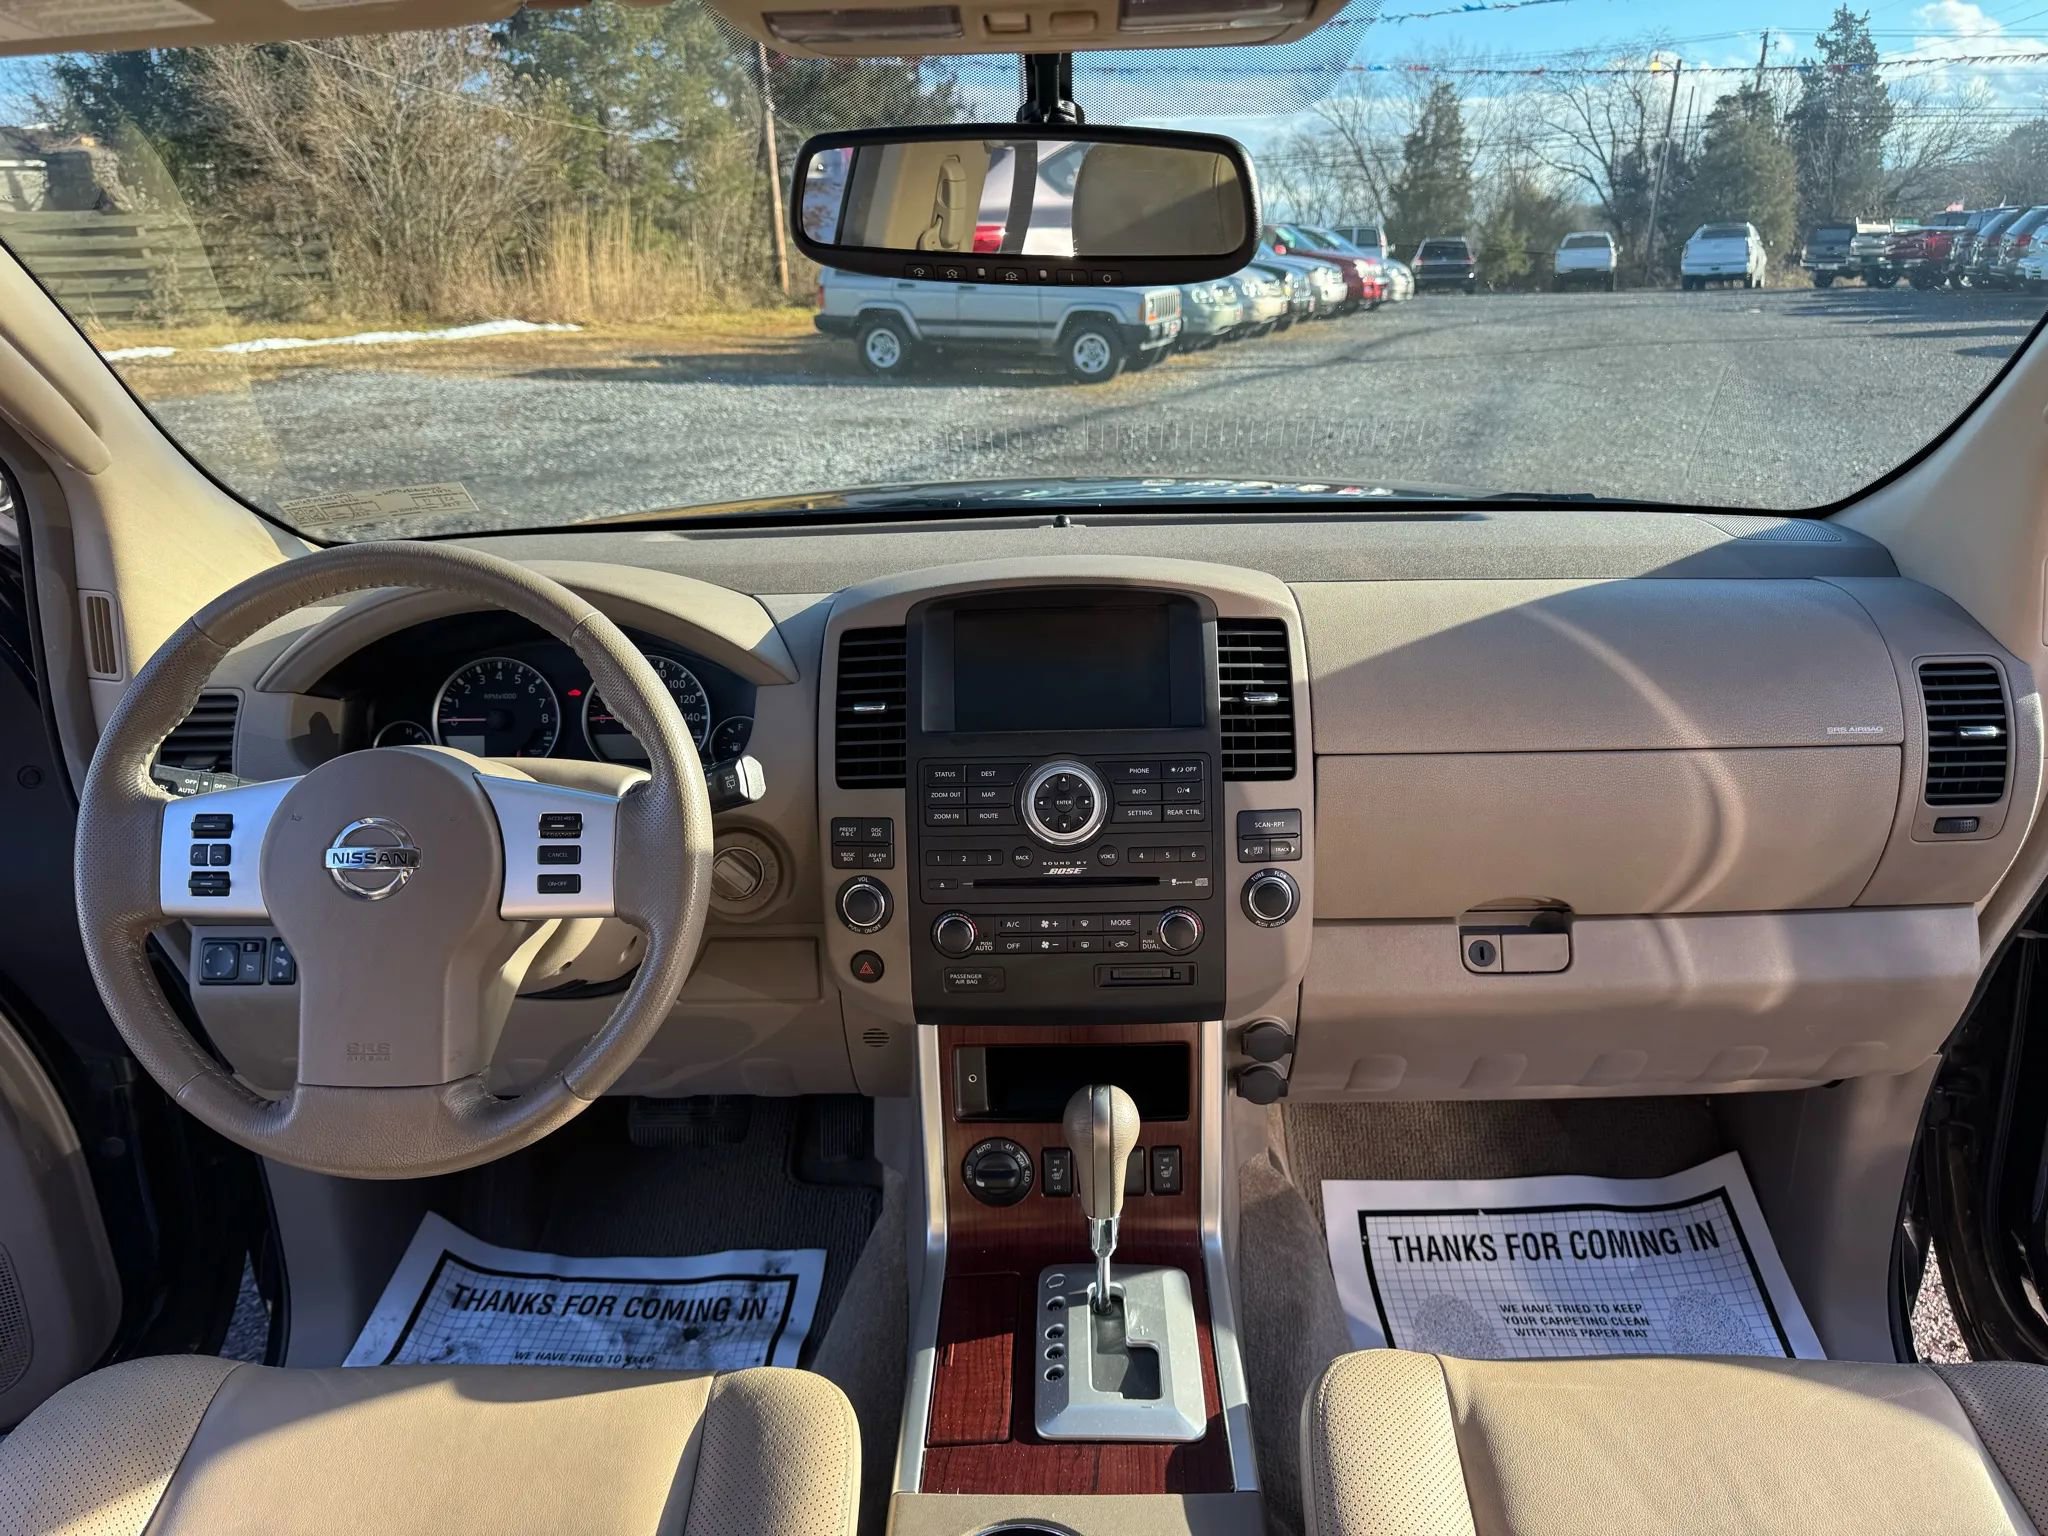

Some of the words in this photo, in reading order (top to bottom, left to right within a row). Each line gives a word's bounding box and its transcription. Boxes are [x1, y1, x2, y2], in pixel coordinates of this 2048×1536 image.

[480, 675, 485, 685] 3
[496, 672, 503, 680] 4
[515, 675, 521, 684] 5
[464, 684, 471, 694] 2
[528, 684, 535, 694] 6
[669, 680, 686, 689] 100
[455, 699, 459, 708] 1
[539, 698, 546, 708] 7
[680, 695, 696, 704] 120
[541, 713, 549, 723] 8
[684, 713, 700, 721] 140
[178, 787, 196, 795] AUTO
[332, 852, 408, 865] NISSAN
[987, 854, 992, 862] 3
[1043, 867, 1087, 875] BOSE
[976, 1143, 992, 1155] AUTO
[1005, 1143, 1015, 1151] 4H
[1387, 1234, 1498, 1263] THANKS
[1504, 1231, 1562, 1262] FOR
[1569, 1227, 1682, 1261] COMING
[1685, 1220, 1720, 1252] IN
[450, 1283, 557, 1316] THANKS
[562, 1294, 618, 1317] FOR
[623, 1296, 731, 1322] COMING
[737, 1296, 769, 1321] IN
[1500, 1304, 1519, 1313] WE
[1522, 1304, 1552, 1313] HAVE
[1554, 1304, 1591, 1313] TRIED
[1593, 1304, 1610, 1313] TO
[1612, 1304, 1642, 1313] KEEP
[1503, 1316, 1537, 1325] YOUR
[1540, 1316, 1608, 1326] CARPETING
[1610, 1316, 1650, 1326] CLEAN
[1514, 1328, 1546, 1337] WITH
[1550, 1328, 1577, 1337] THIS
[1581, 1329, 1619, 1338] PAPER
[1623, 1329, 1648, 1338] MAT
[514, 1351, 533, 1359] WE
[535, 1351, 567, 1361] HAVE
[570, 1353, 603, 1363] TRIED
[608, 1354, 622, 1363] TO
